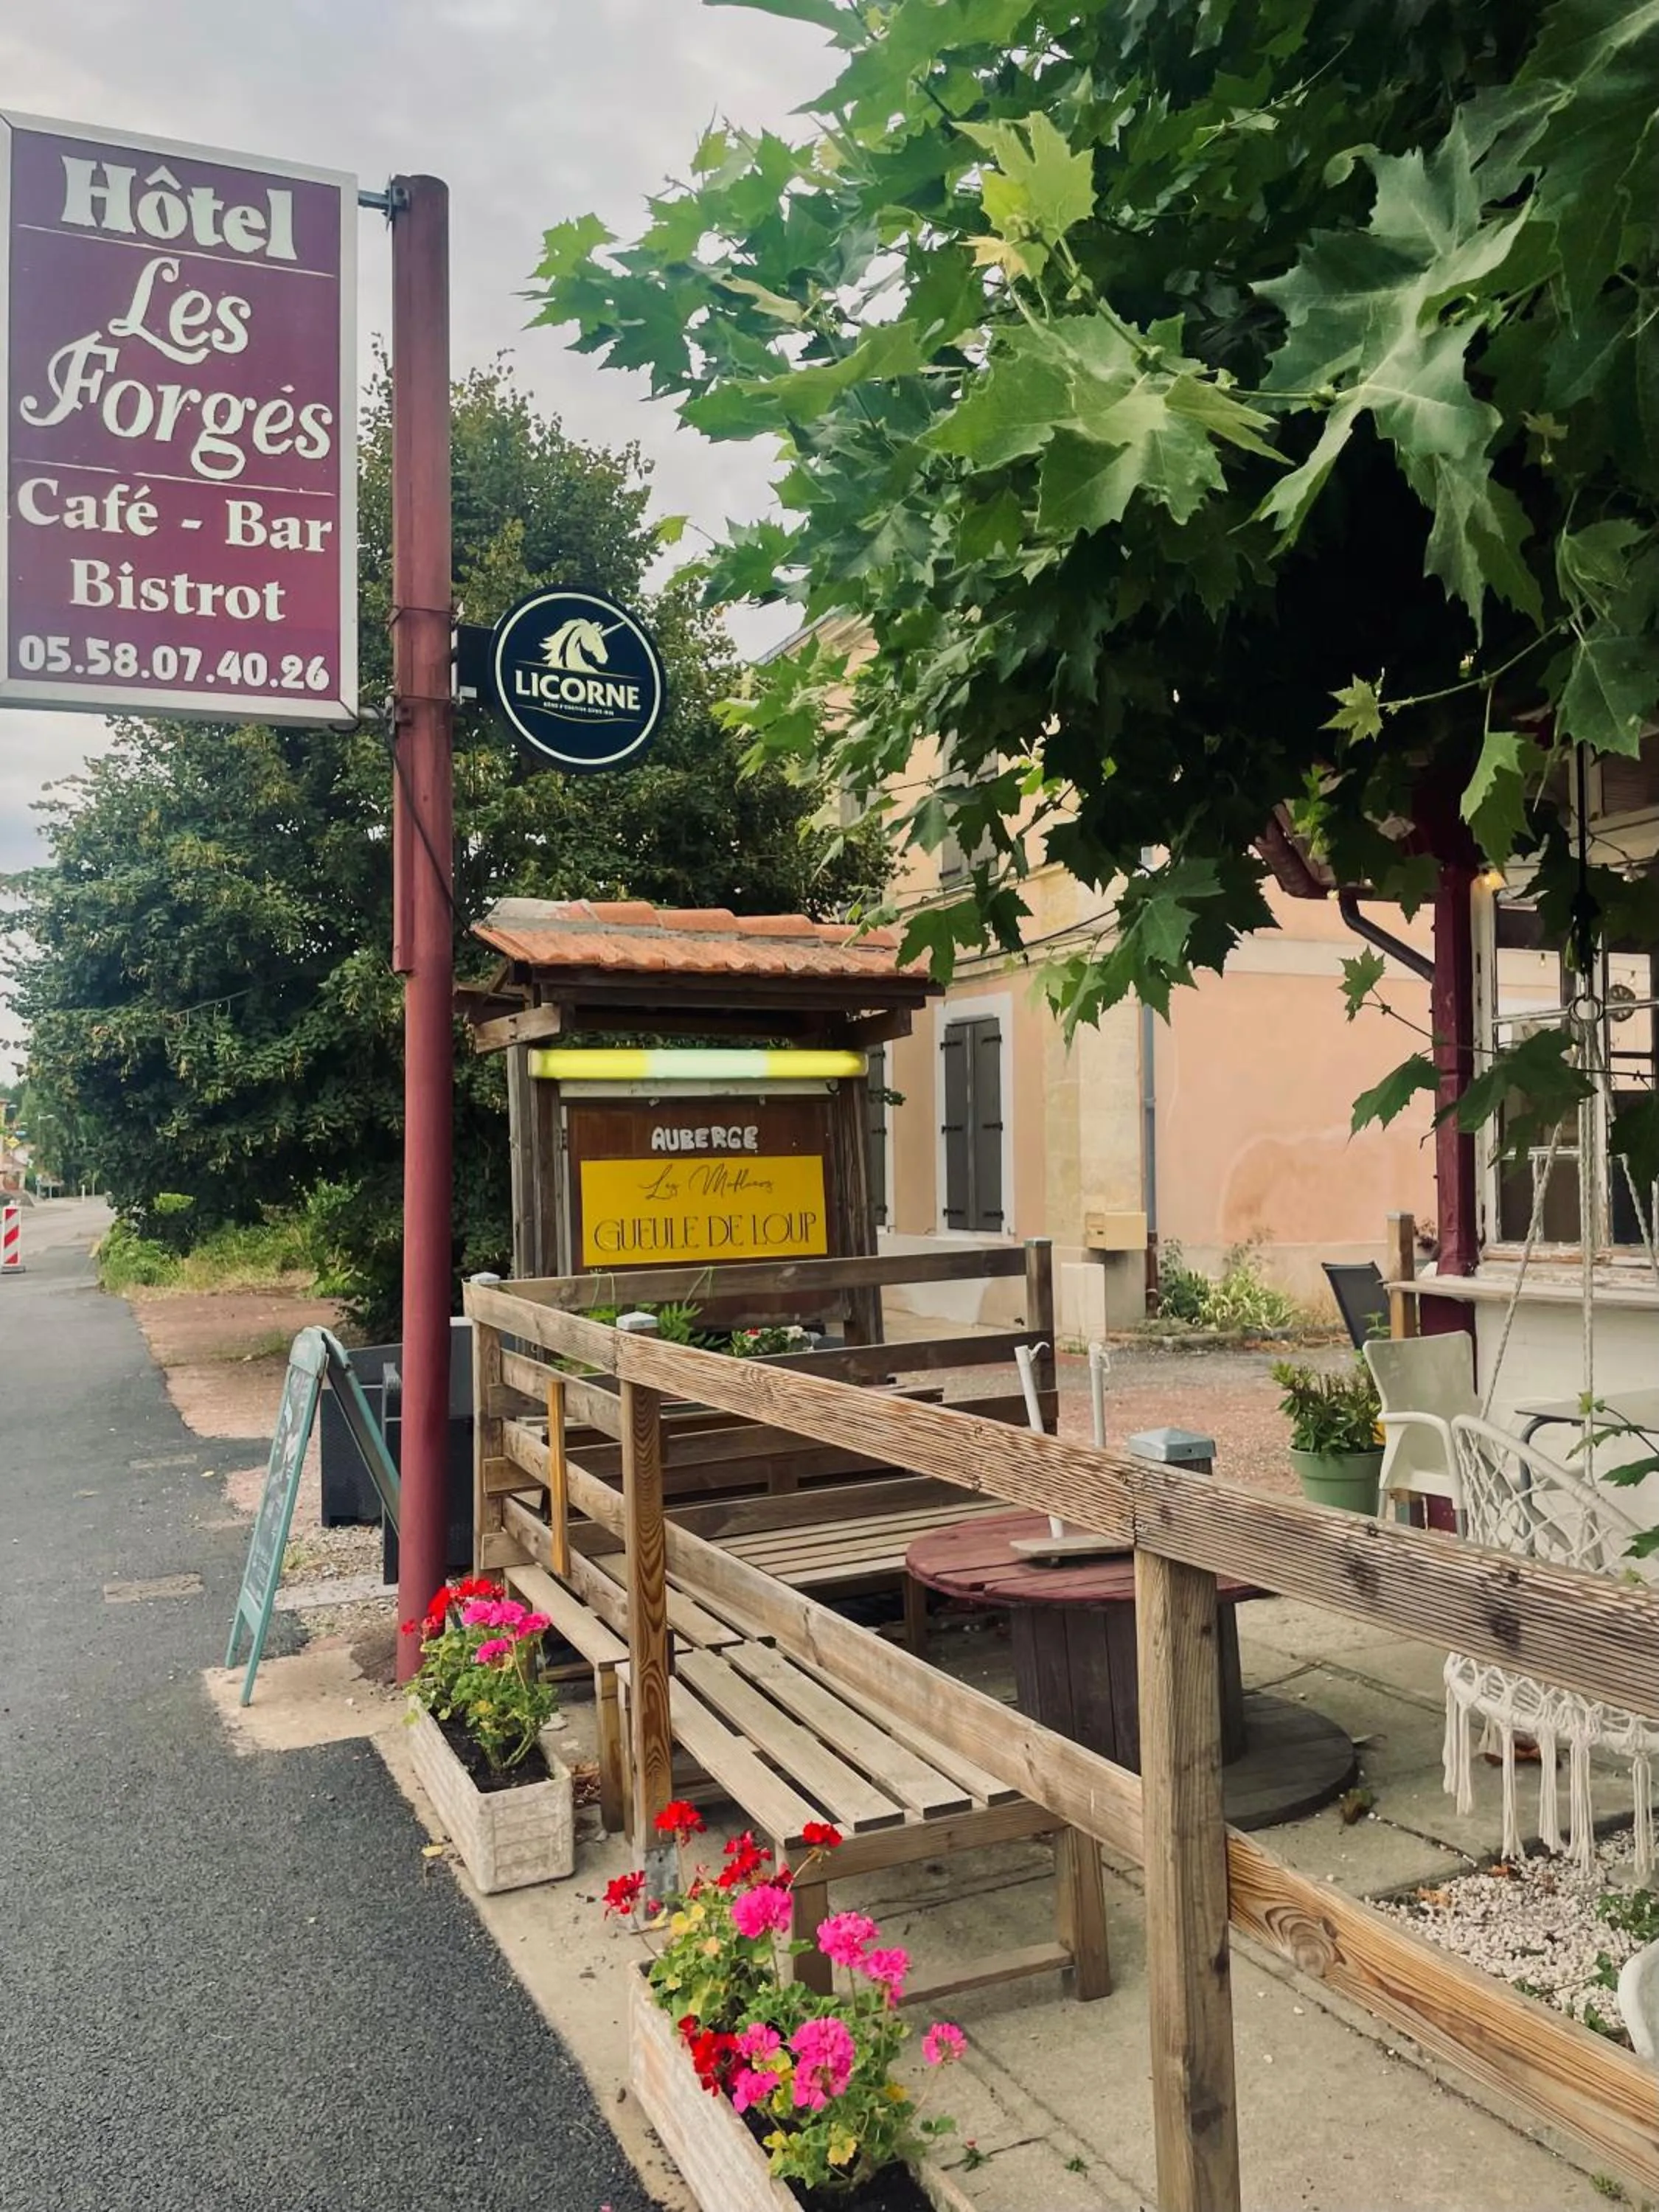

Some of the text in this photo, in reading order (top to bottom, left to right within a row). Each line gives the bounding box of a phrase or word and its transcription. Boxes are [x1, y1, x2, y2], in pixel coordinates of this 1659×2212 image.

[60, 156, 297, 260] Hôtel
[108, 257, 251, 365] Les
[18, 478, 159, 536] Café
[225, 499, 333, 552] Bar
[70, 558, 286, 622] Bistrot
[18, 636, 330, 692] 05.58.07.40.26
[515, 669, 641, 711] LICORNE
[651, 1125, 759, 1151] AUBERGE
[594, 1211, 817, 1252] GUEULE DE LOUP
